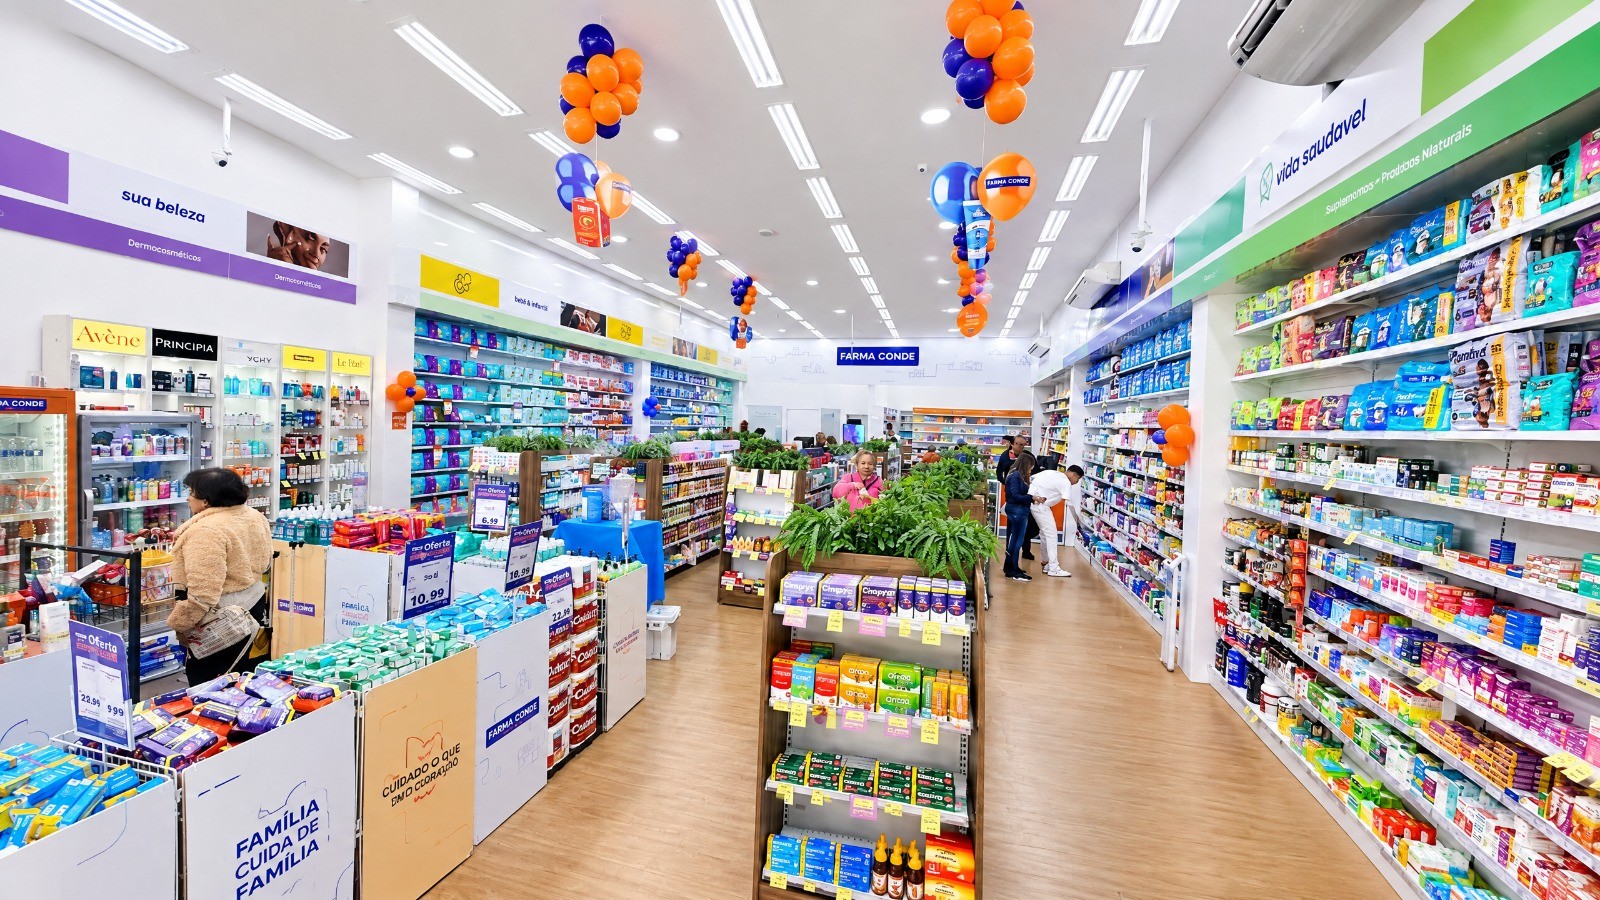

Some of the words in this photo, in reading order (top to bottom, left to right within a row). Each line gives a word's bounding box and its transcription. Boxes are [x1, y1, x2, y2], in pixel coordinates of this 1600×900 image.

[1276, 156, 1300, 186] vida
[1302, 98, 1367, 166] saudavel
[121, 190, 151, 208] sua
[155, 197, 205, 224] beleza
[128, 238, 202, 263] Dermocosméticos
[274, 273, 322, 290] Dermocosméticos
[76, 325, 140, 348] Avène
[155, 337, 214, 353] PRINCIPIA
[840, 352, 876, 361] FARMA
[878, 352, 915, 361] CONDE
[424, 540, 450, 551] Oferta
[410, 588, 444, 607] 10.99
[488, 718, 513, 740] FARMA
[514, 701, 538, 721] CONDE
[382, 763, 429, 798] CUIDADO
[431, 756, 440, 767] O
[441, 742, 461, 761] QUE
[236, 798, 320, 860] FAMÍLIA
[235, 835, 293, 880] CUIDA
[297, 816, 319, 842] DE
[236, 838, 320, 900] FAMÍLIA
